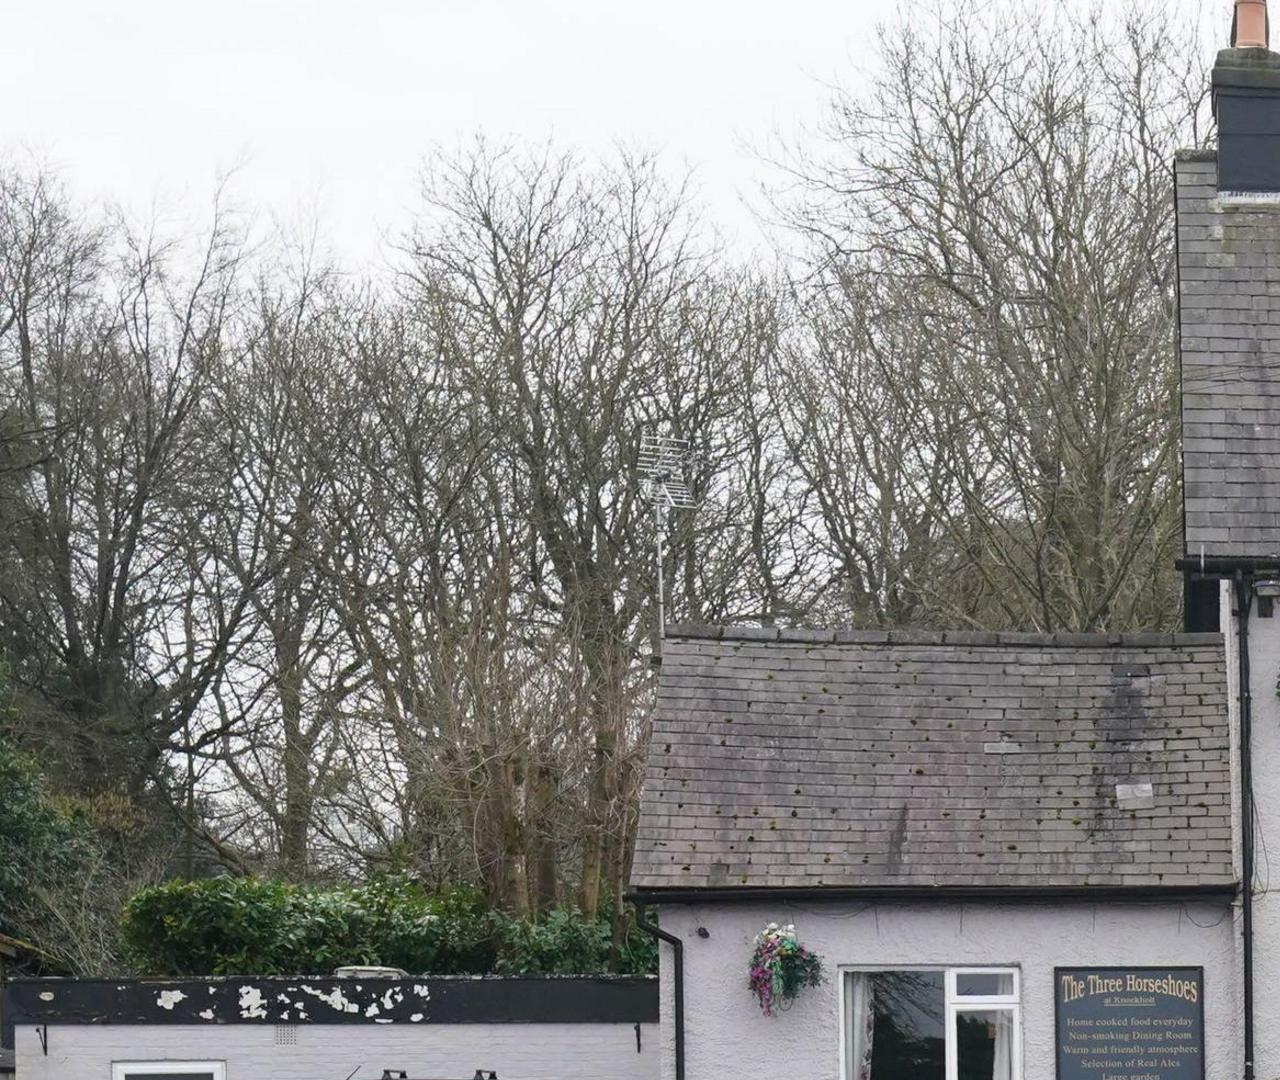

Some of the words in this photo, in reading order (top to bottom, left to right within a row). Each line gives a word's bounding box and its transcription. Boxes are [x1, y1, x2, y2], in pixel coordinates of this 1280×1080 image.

[1062, 975, 1085, 1003] The
[1087, 974, 1123, 995] Three
[1126, 974, 1198, 1003] Horseshoes
[1067, 1018, 1093, 1026] Home
[1095, 1018, 1127, 1026] cooked
[1130, 1017, 1150, 1026] food
[1152, 1018, 1193, 1028] everyday
[1070, 1032, 1129, 1042] Non-smoking
[1132, 1031, 1162, 1041] Dining
[1165, 1031, 1192, 1039] Room
[1063, 1045, 1089, 1054] Warm
[1092, 1045, 1108, 1054] and
[1110, 1045, 1144, 1055] friendly
[1147, 1045, 1199, 1055] atmosphere
[1081, 1060, 1122, 1068] Selection
[1125, 1059, 1134, 1068] of
[1137, 1059, 1157, 1068] Real
[1160, 1059, 1180, 1067] Ales
